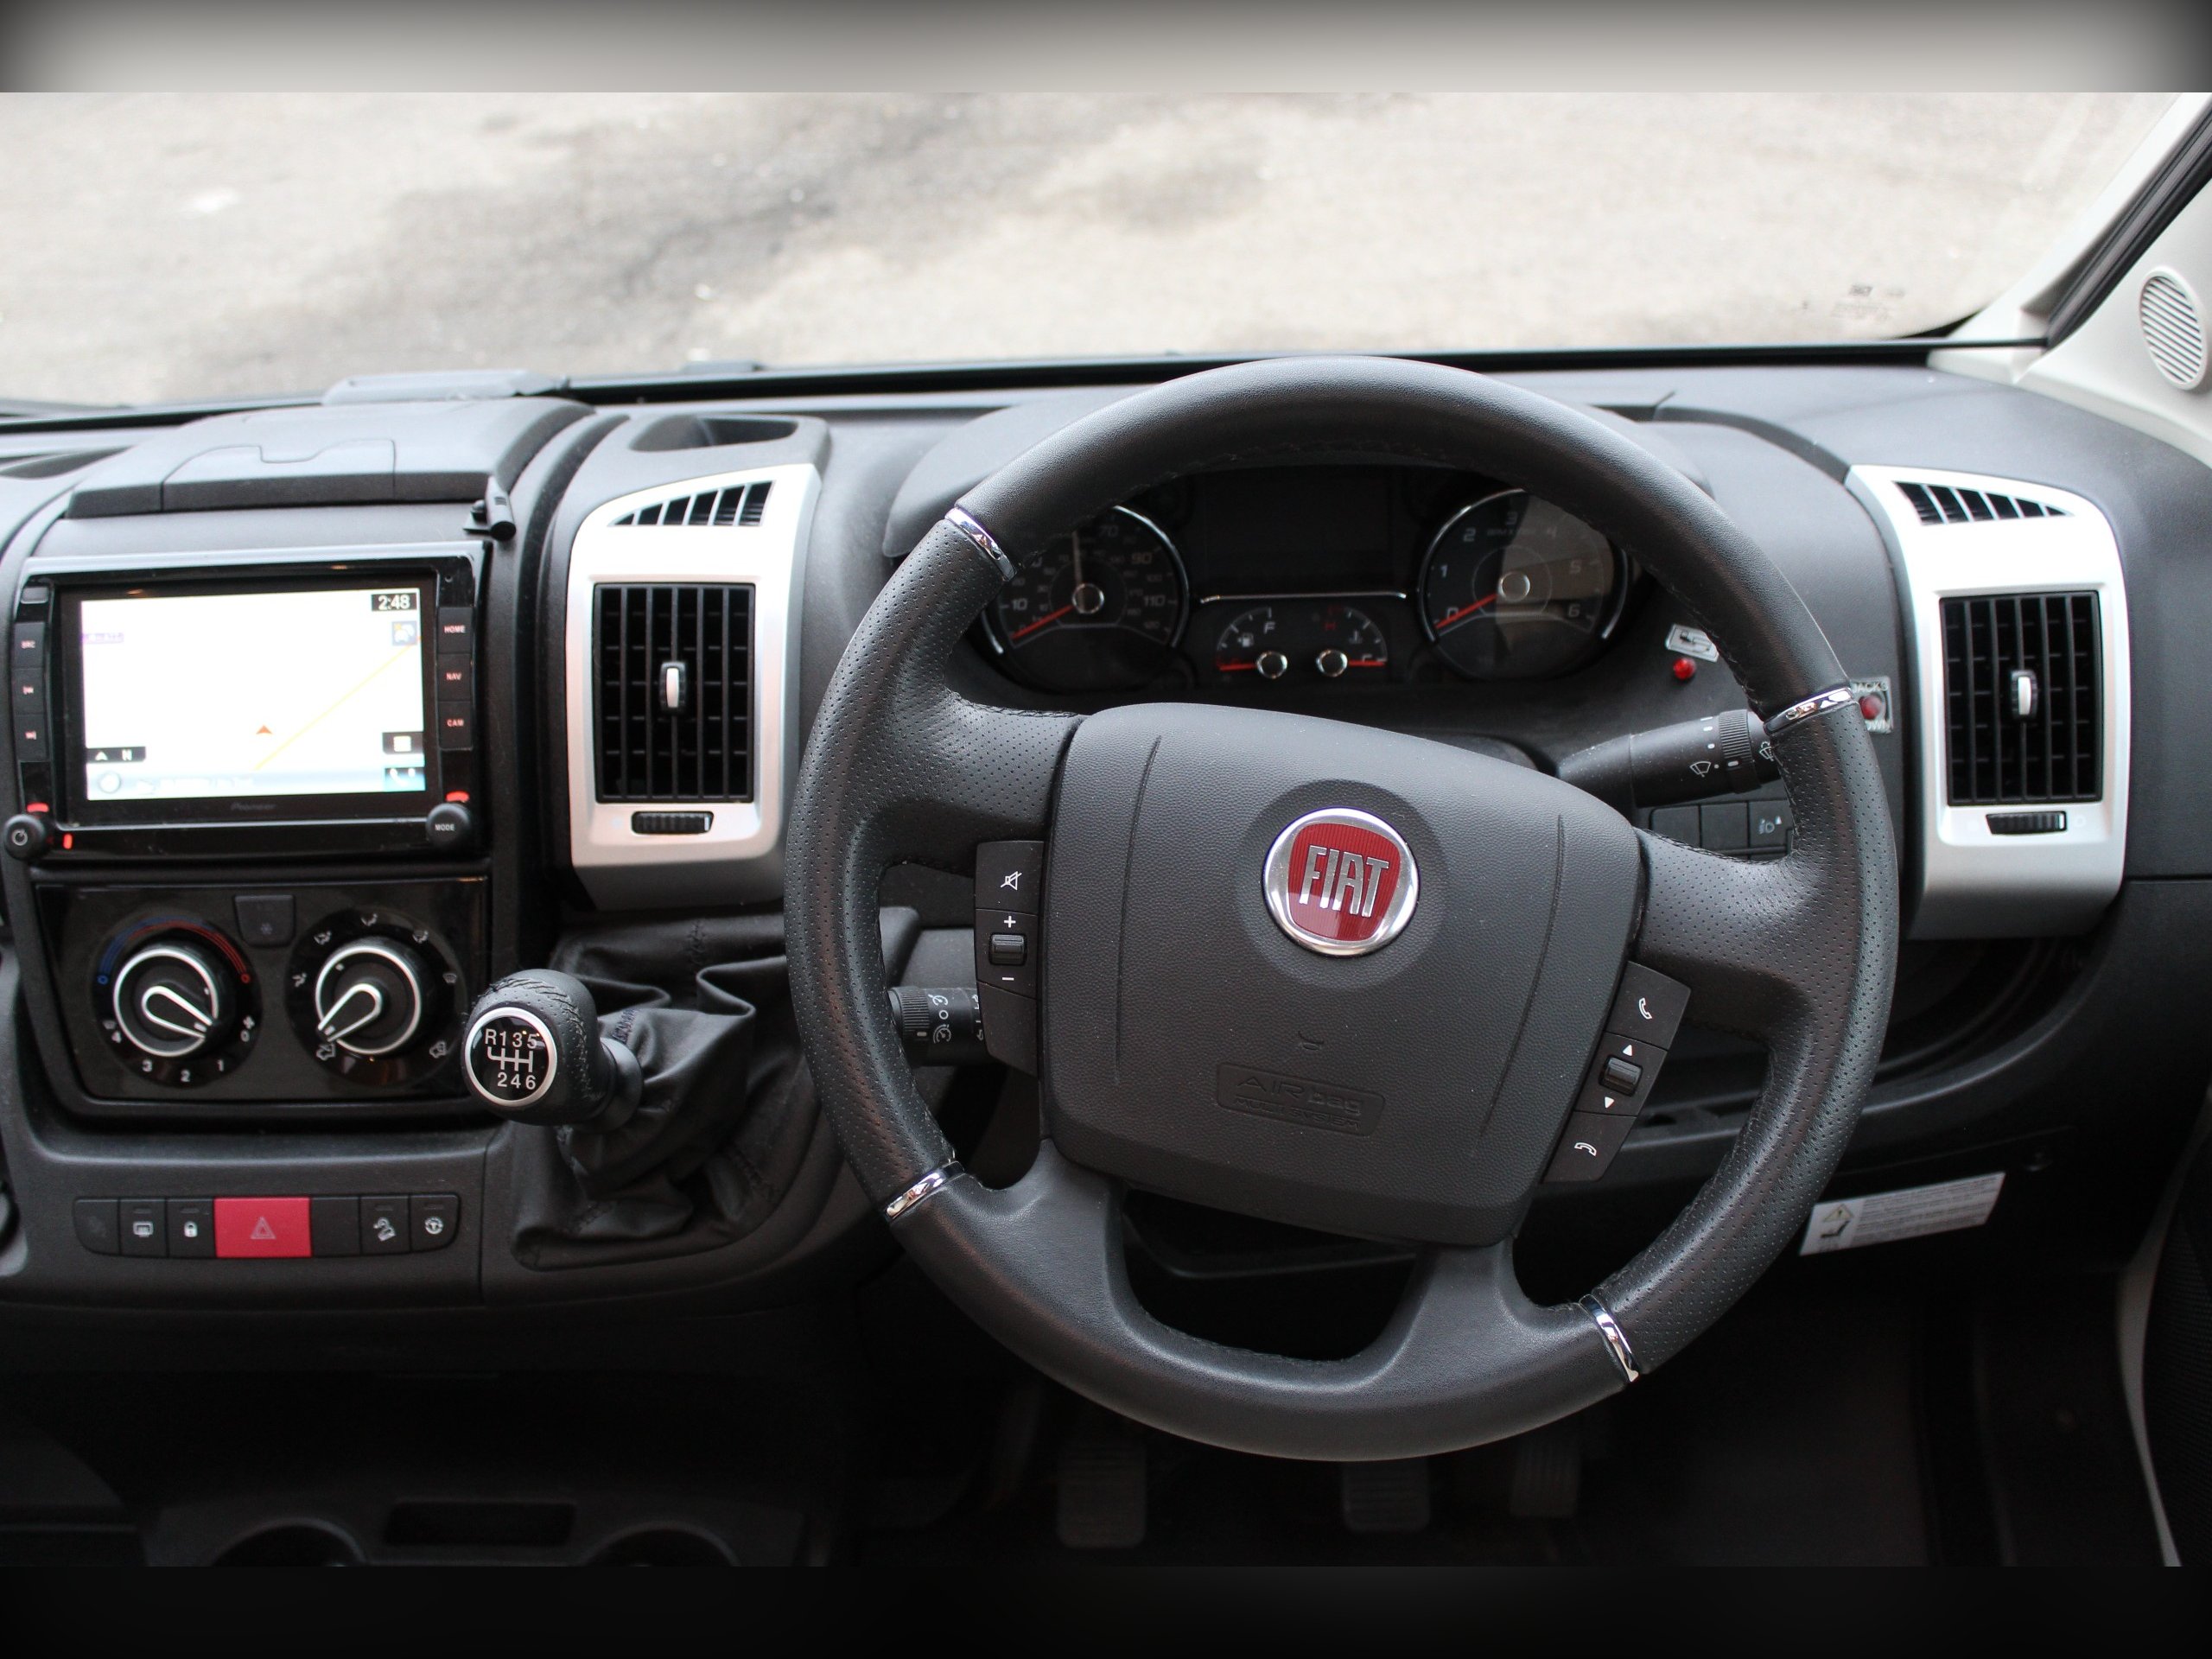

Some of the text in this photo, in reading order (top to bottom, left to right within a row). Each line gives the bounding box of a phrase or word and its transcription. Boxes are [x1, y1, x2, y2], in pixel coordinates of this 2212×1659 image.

[1463, 527, 1476, 543] 2
[1131, 552, 1153, 565] 90
[1440, 564, 1449, 577] 1
[1568, 560, 1582, 574] 5
[378, 594, 410, 610] 2:48
[1012, 598, 1028, 611] 10
[1143, 594, 1166, 607] 110
[1567, 604, 1581, 618] 6
[444, 625, 466, 633] HOME
[1263, 622, 1275, 634] F
[1299, 845, 1389, 918] FIAT
[111, 1031, 122, 1044] 4
[142, 1058, 153, 1072] 3
[217, 1059, 225, 1071] 1
[181, 1069, 191, 1082] 2
